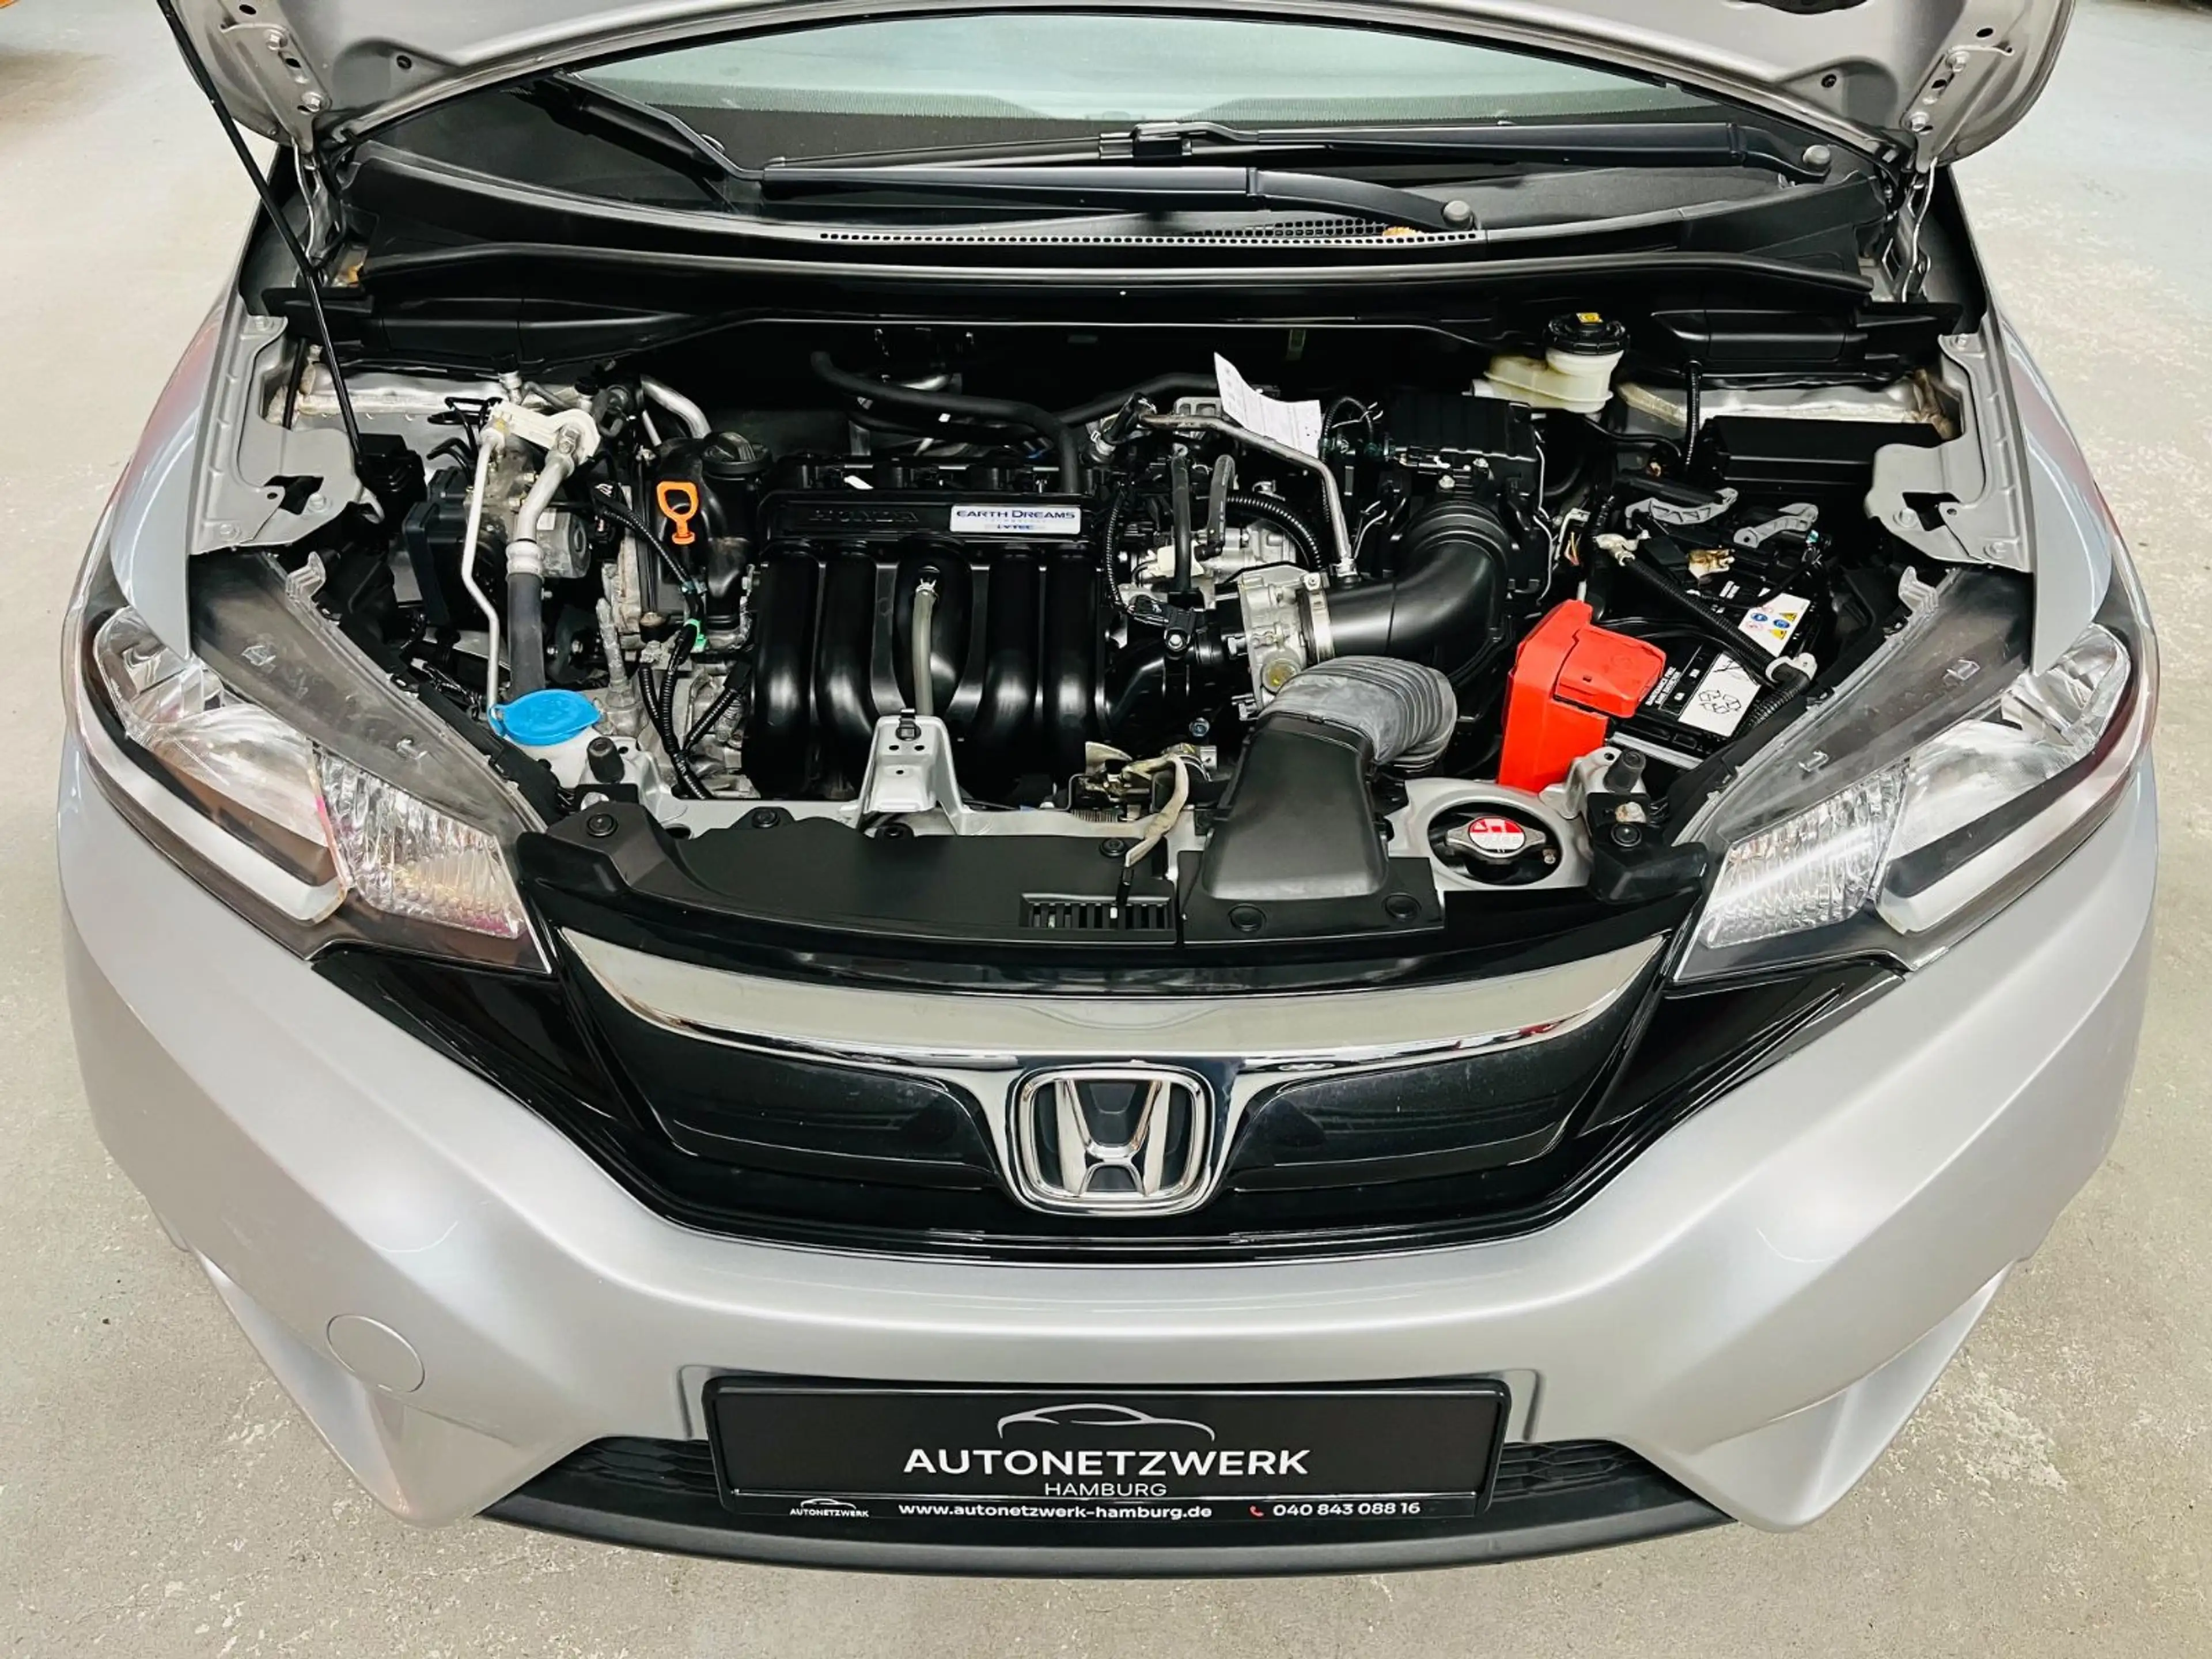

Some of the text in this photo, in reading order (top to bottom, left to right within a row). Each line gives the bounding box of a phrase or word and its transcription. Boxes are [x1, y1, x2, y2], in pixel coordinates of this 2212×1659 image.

[1012, 510, 1075, 519] DREAMS
[903, 1449, 1310, 1476] AUTONETZWERK
[1045, 1482, 1168, 1497] HAMBURG
[789, 1508, 869, 1517] AUTONETZWERK
[898, 1504, 1212, 1520] www.autonetzwerk-hamburg.de
[1272, 1502, 1421, 1516] 040 843 088 16
